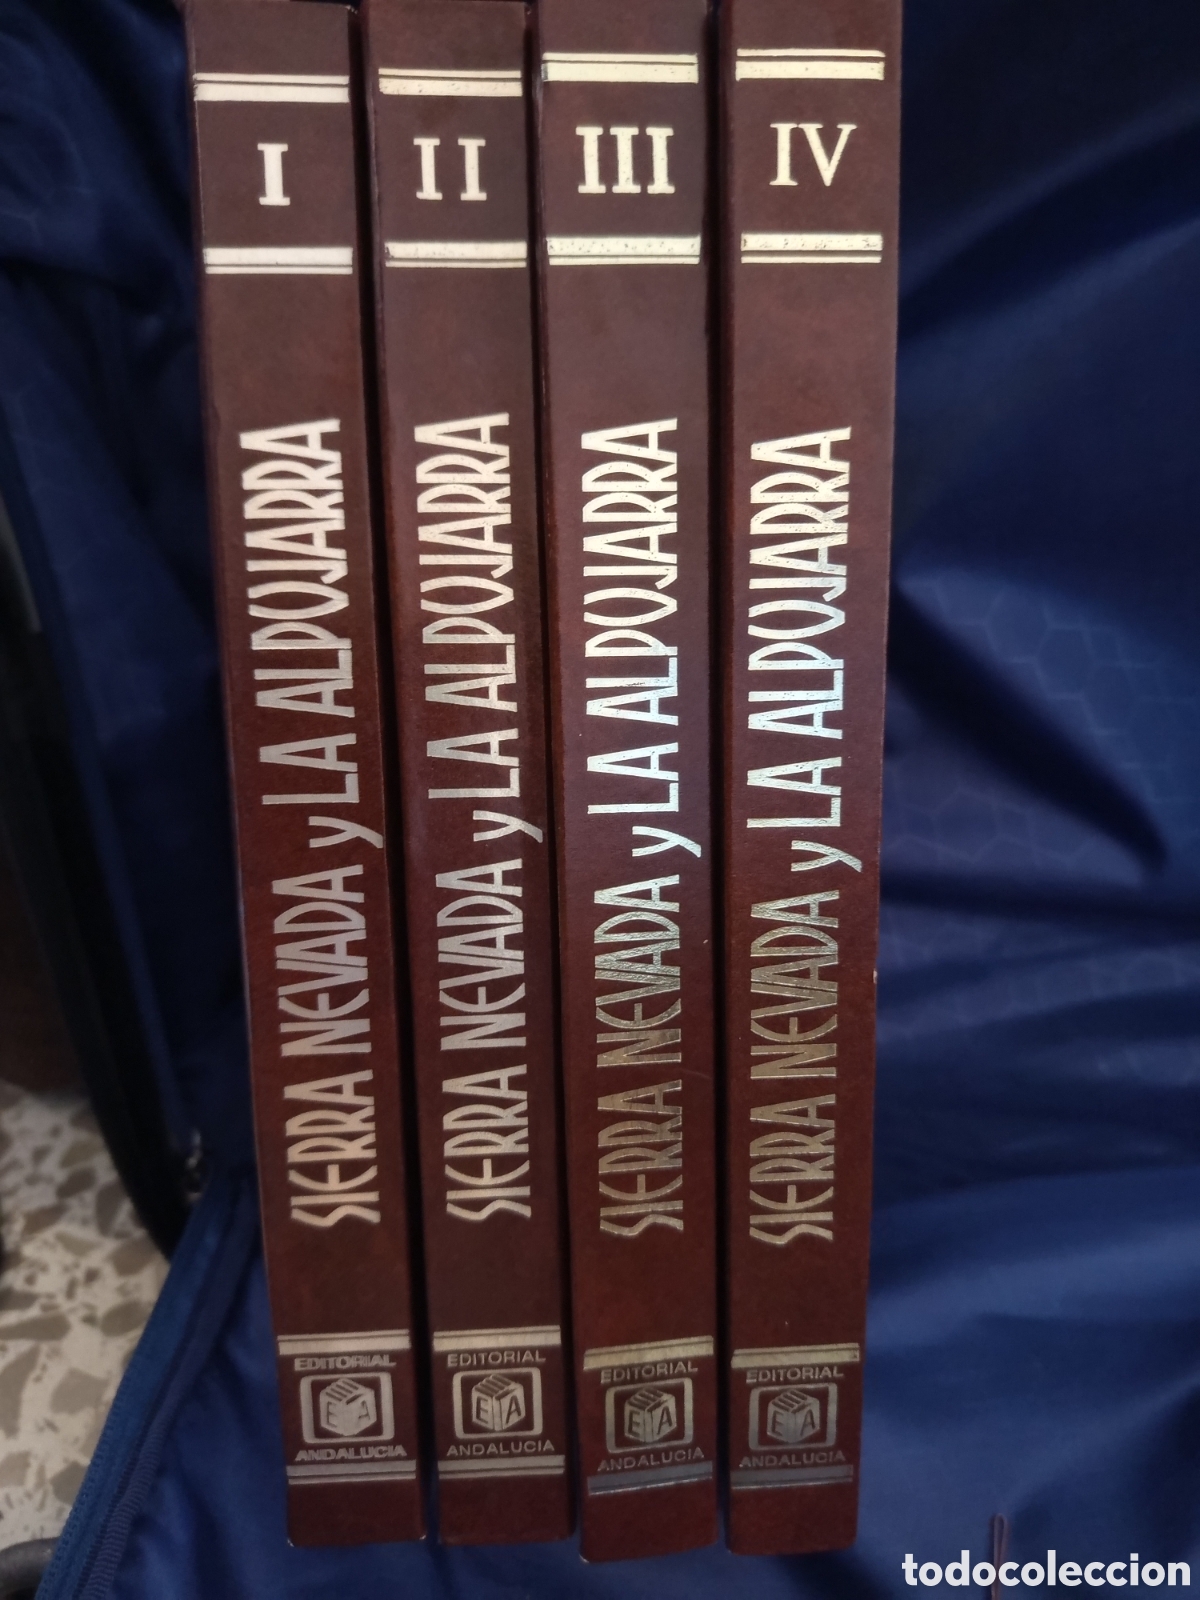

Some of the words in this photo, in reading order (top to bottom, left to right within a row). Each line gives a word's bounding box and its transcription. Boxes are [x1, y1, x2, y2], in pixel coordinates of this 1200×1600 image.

[257, 143, 291, 206] I
[575, 126, 676, 194] III
[769, 122, 857, 187] IV
[239, 418, 355, 718] ALPUJARRA
[414, 412, 518, 712] ALPUJARRA
[581, 417, 679, 726] ALPUJARRA
[747, 426, 852, 740] ALPUJARRA
[259, 732, 360, 805] LA
[426, 728, 520, 799] LA
[587, 742, 679, 814] LA
[746, 756, 842, 828] LA
[308, 815, 384, 849] y
[472, 809, 544, 843] y
[631, 825, 702, 858] y
[790, 840, 863, 873] y
[272, 864, 372, 1057] NEVADA
[435, 858, 527, 1051] NEVADA
[594, 874, 682, 1067] NEVADA
[750, 889, 840, 1080] NEVADA
[283, 1069, 381, 1228] SIERRA
[442, 1064, 532, 1221] SIERRA
[597, 1079, 684, 1237] SIERRA
[749, 1093, 837, 1246] SIERRA
[294, 1354, 397, 1372] EDITORIAL
[447, 1350, 547, 1368] EDITORIAL
[600, 1361, 699, 1384] EDITORIAL
[746, 1366, 844, 1383] EDITORIAL
[294, 1444, 408, 1462] ANDALUCIA
[446, 1439, 556, 1457] ANDALUCIA
[597, 1446, 705, 1472] ANDALUCIA
[739, 1450, 846, 1468] ANDALUCIA
